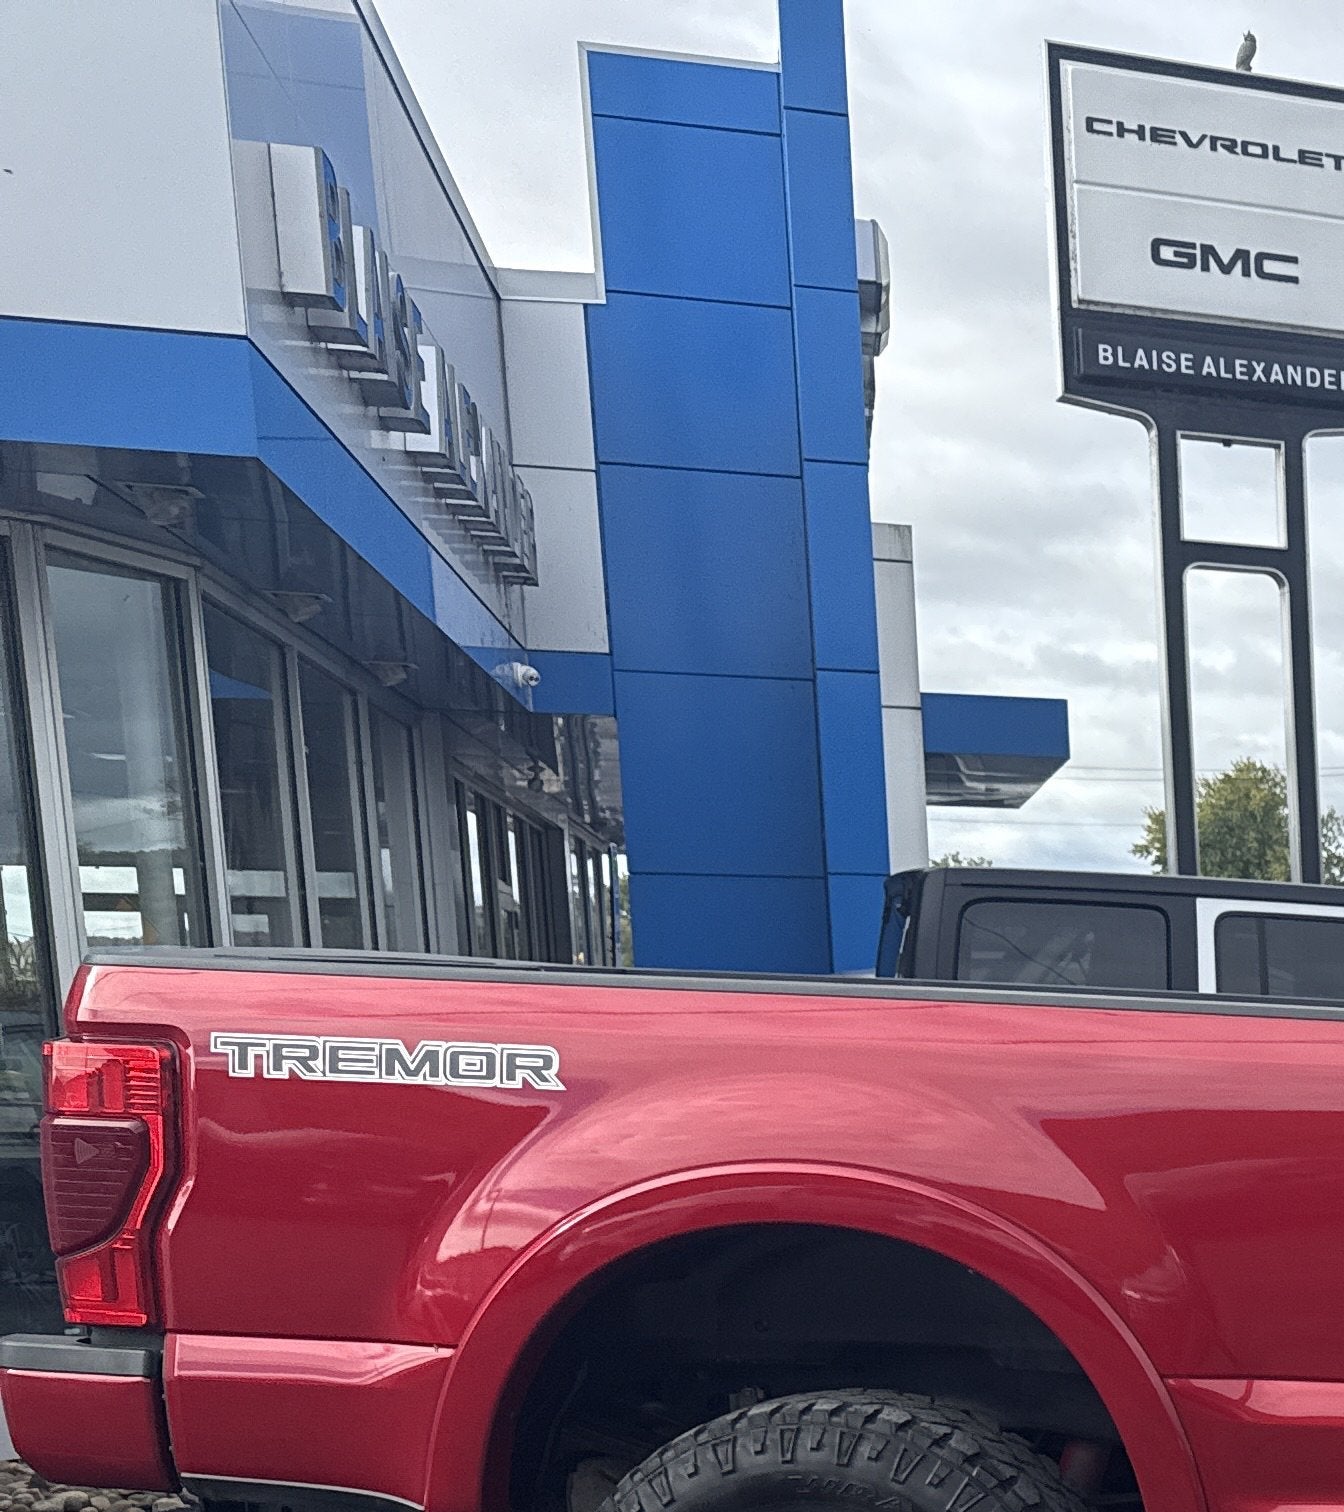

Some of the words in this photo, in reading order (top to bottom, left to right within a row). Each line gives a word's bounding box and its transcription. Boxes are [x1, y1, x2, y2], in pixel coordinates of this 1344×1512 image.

[1150, 237, 1300, 285] GMC
[1097, 342, 1195, 375] BLAISE
[210, 1031, 567, 1091] TREMOR
